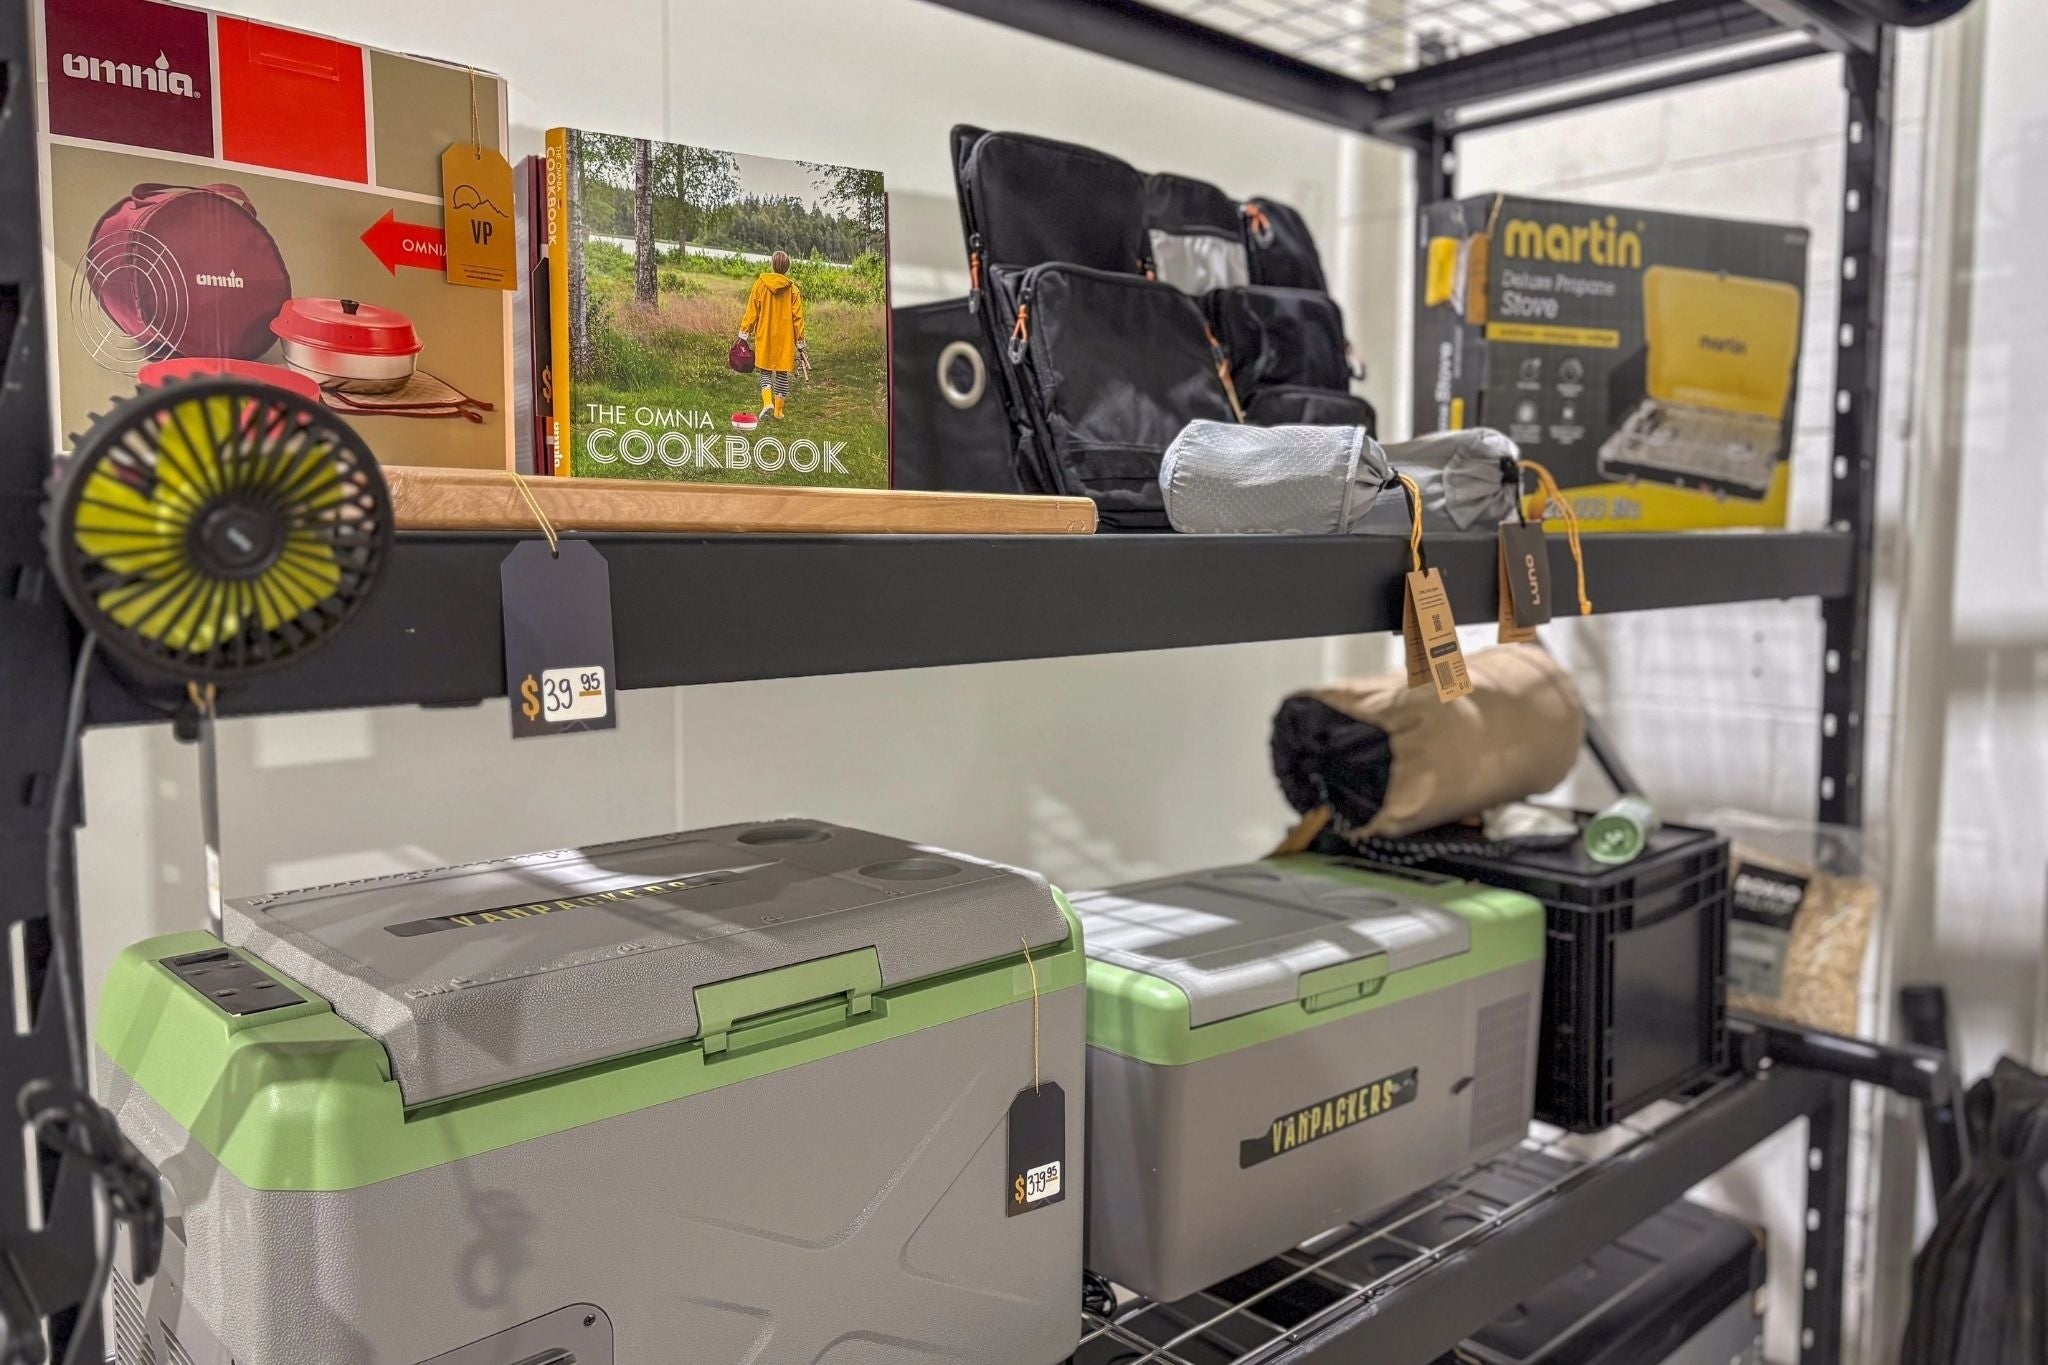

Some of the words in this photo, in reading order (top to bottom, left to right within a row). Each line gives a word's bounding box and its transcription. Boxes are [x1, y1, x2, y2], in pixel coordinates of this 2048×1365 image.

[63, 49, 194, 98] omnia
[546, 146, 557, 246] COOKBOOK
[471, 219, 493, 245] VP
[1504, 214, 1642, 269] martin
[196, 268, 244, 289] omnia
[1500, 290, 1559, 319] Stove
[587, 403, 626, 425] THE
[635, 406, 715, 430] OMNIA
[587, 428, 849, 474] COOKBOOK
[1272, 1079, 1394, 1154] VANPACKERS
